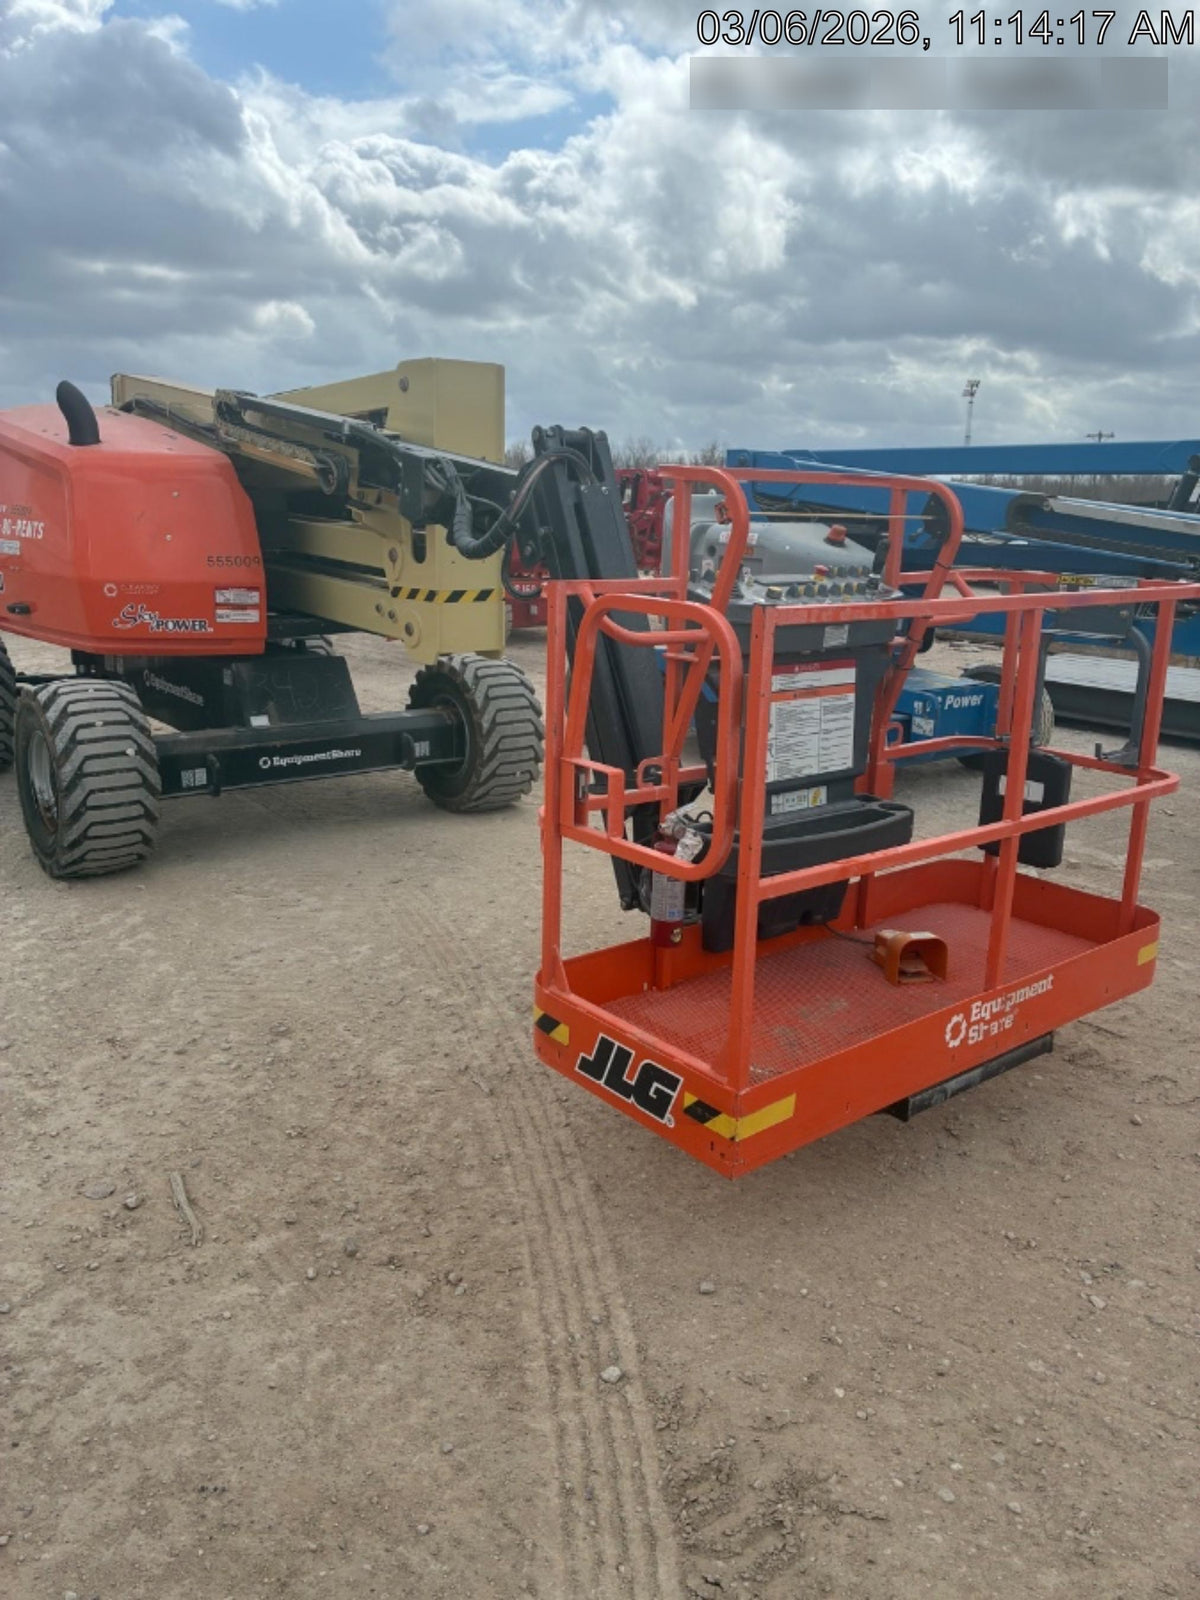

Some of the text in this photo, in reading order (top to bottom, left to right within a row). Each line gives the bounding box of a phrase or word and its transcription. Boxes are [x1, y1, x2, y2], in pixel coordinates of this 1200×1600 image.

[207, 555, 260, 568] 555009
[155, 619, 208, 633] POWER
[944, 694, 983, 711] Power
[574, 1032, 684, 1124] JLG
